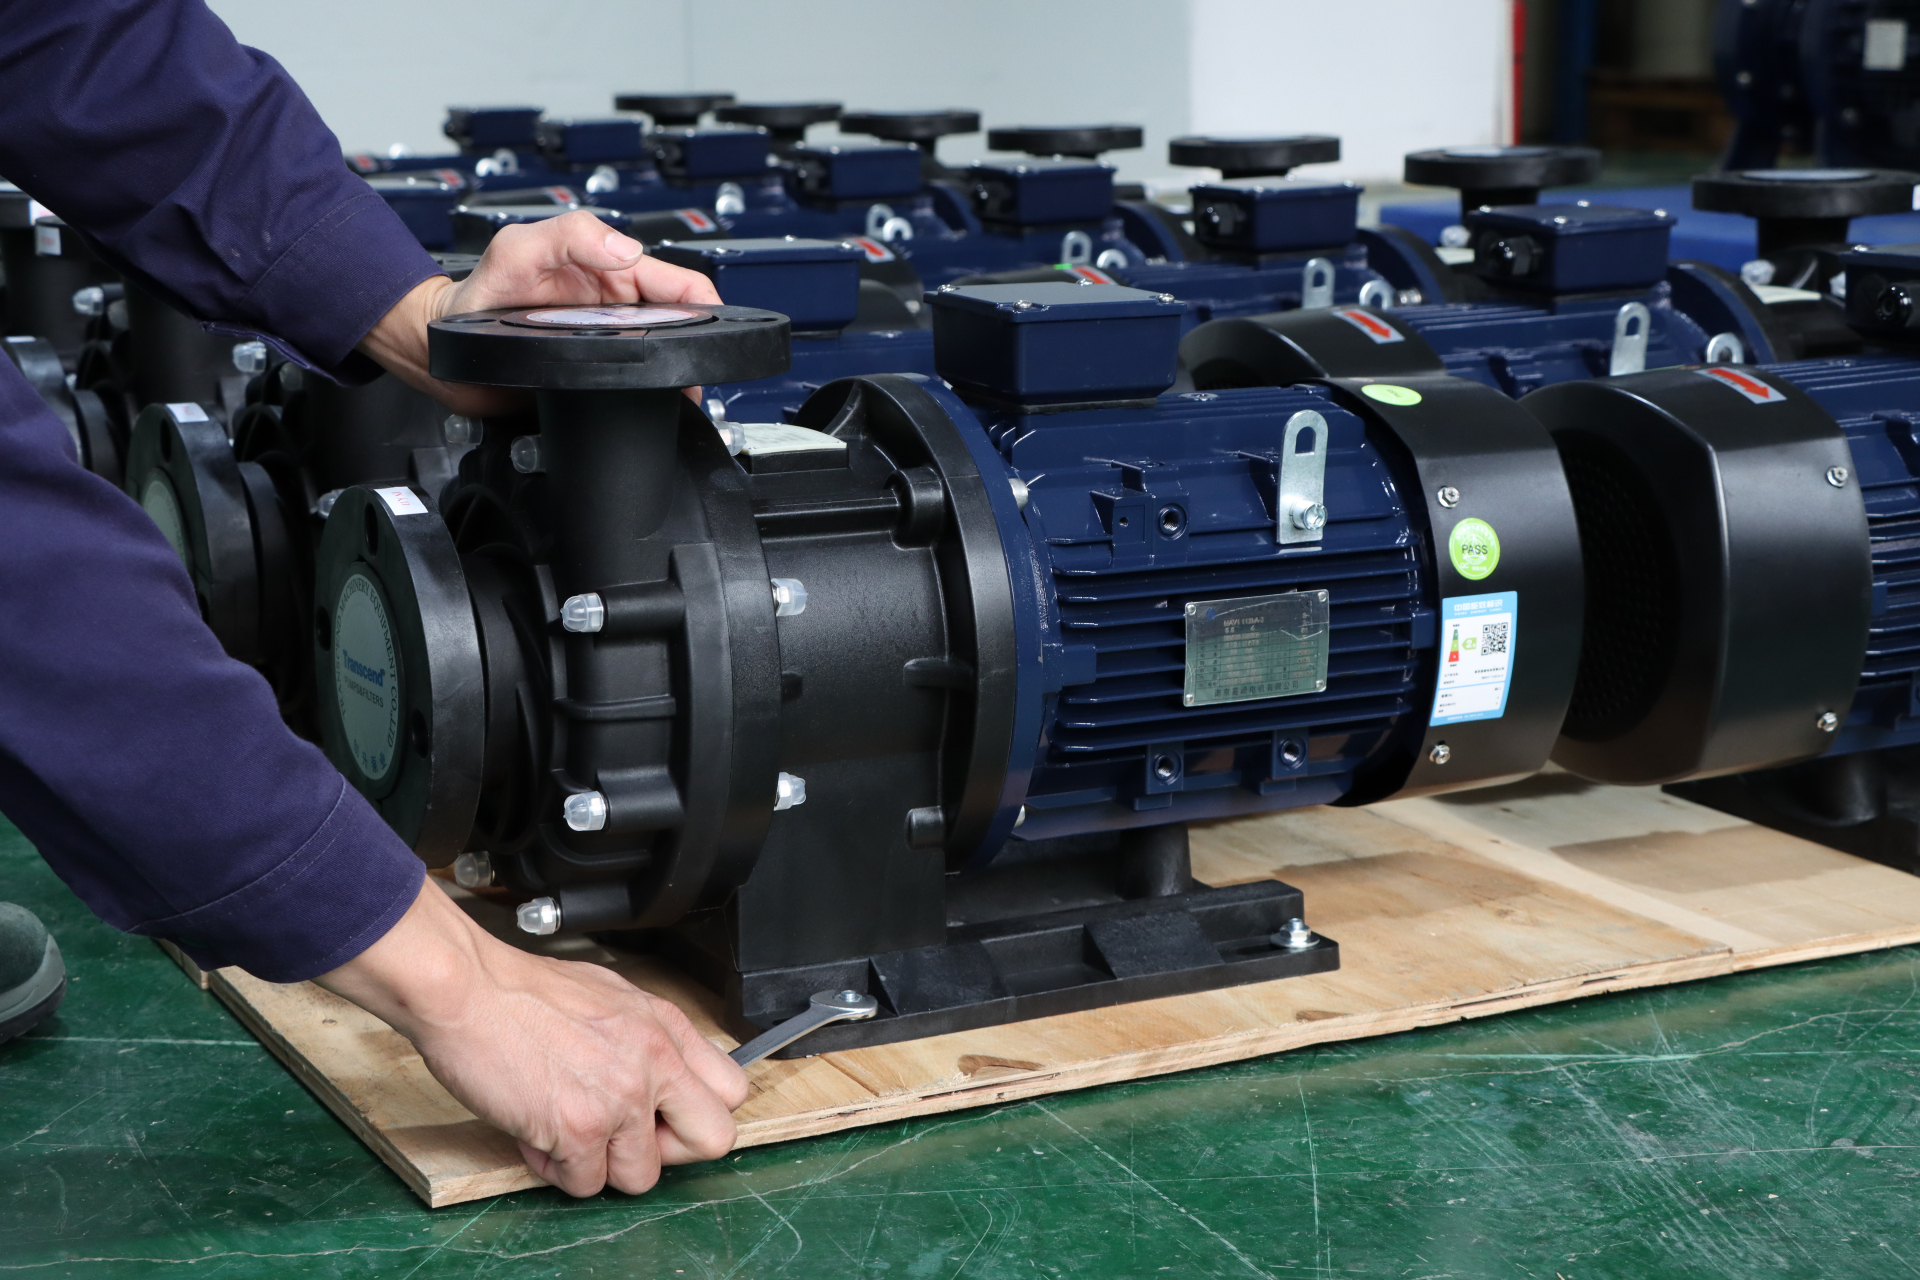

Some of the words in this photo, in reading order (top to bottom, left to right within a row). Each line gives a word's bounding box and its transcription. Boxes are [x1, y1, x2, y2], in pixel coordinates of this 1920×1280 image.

[1461, 544, 1488, 555] PASS
[1454, 599, 1503, 611] 中国能效标识
[339, 577, 370, 616] MACHINERY
[369, 588, 397, 681] EQUIPMENT
[344, 676, 384, 708] PUMPS&FILTERS
